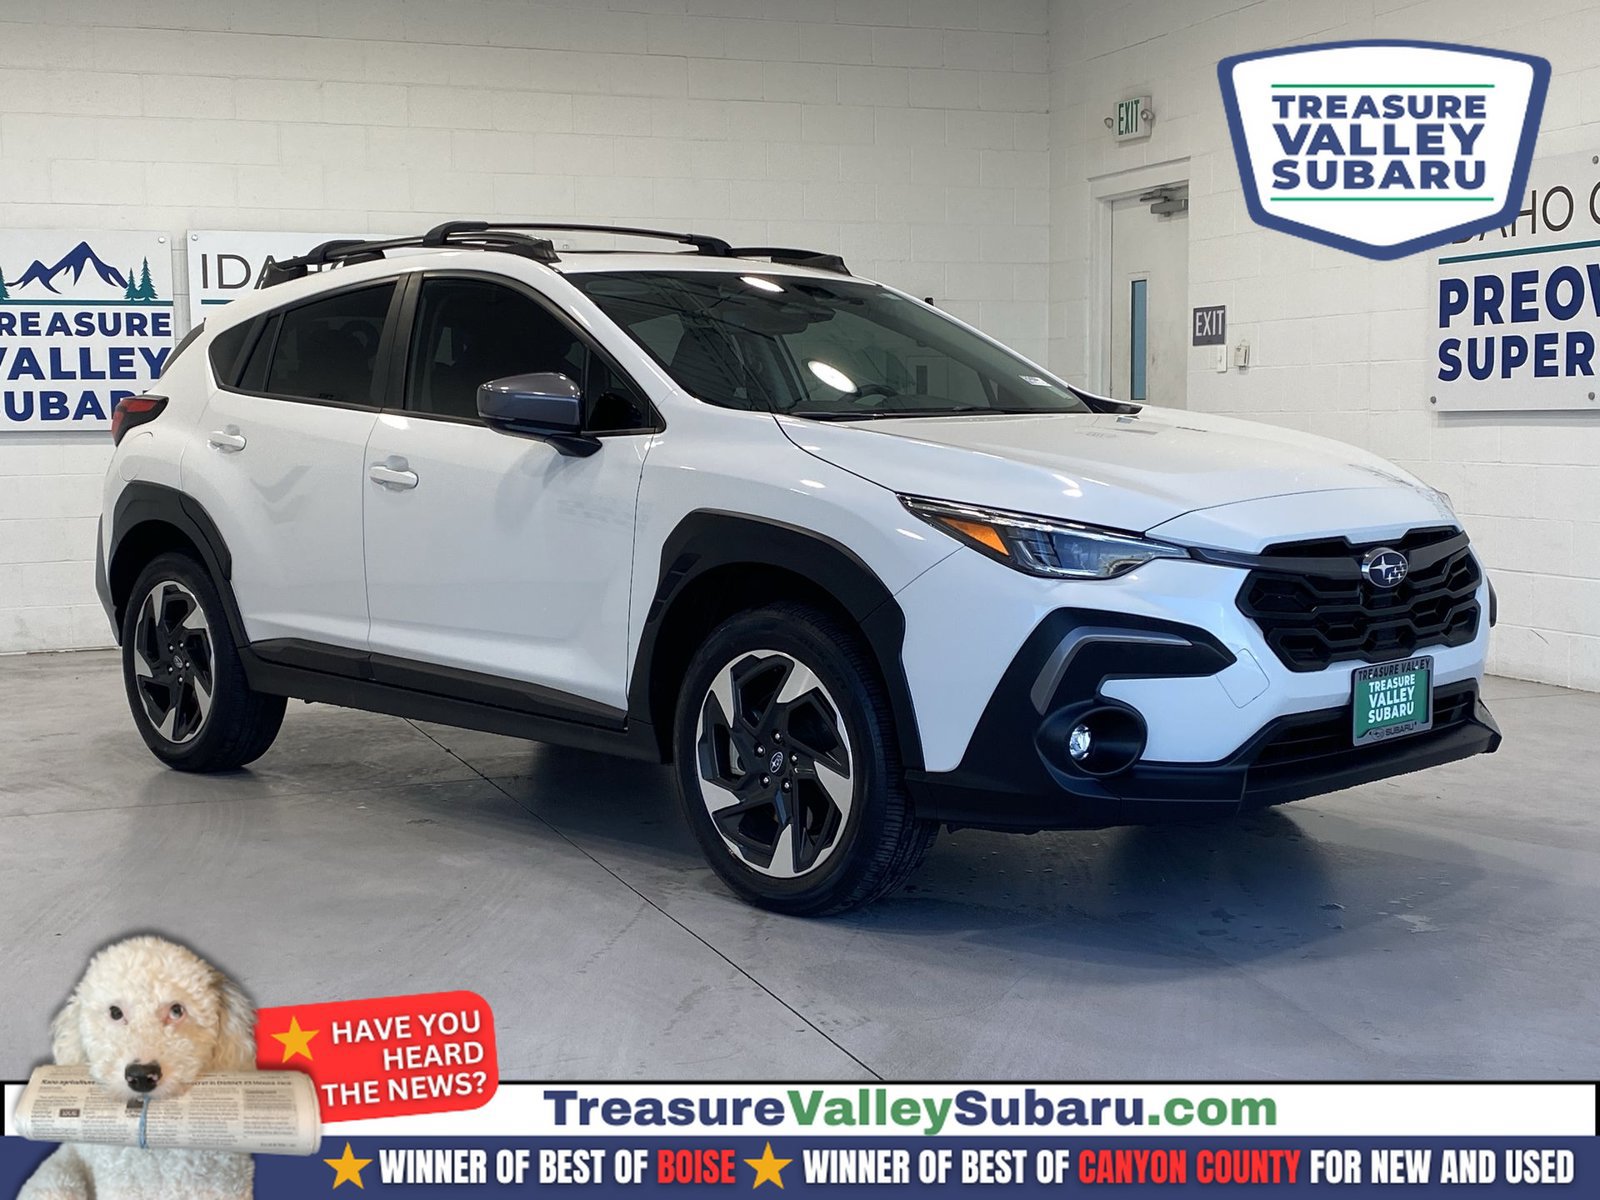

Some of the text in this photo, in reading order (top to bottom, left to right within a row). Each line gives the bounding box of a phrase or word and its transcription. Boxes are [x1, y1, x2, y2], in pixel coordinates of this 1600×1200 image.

[1118, 99, 1141, 136] EXIT
[1439, 264, 1600, 329] PREO
[1195, 309, 1225, 337] EXIT
[0, 347, 172, 381] ALLEY
[1438, 331, 1595, 383] SUPER
[1358, 658, 1431, 682] TREASURE VALLEY
[1368, 674, 1416, 693] TREASURE
[1368, 686, 1415, 709] VALLEY
[1368, 701, 1415, 724] SUBARU
[1385, 723, 1415, 736] SUBARU
